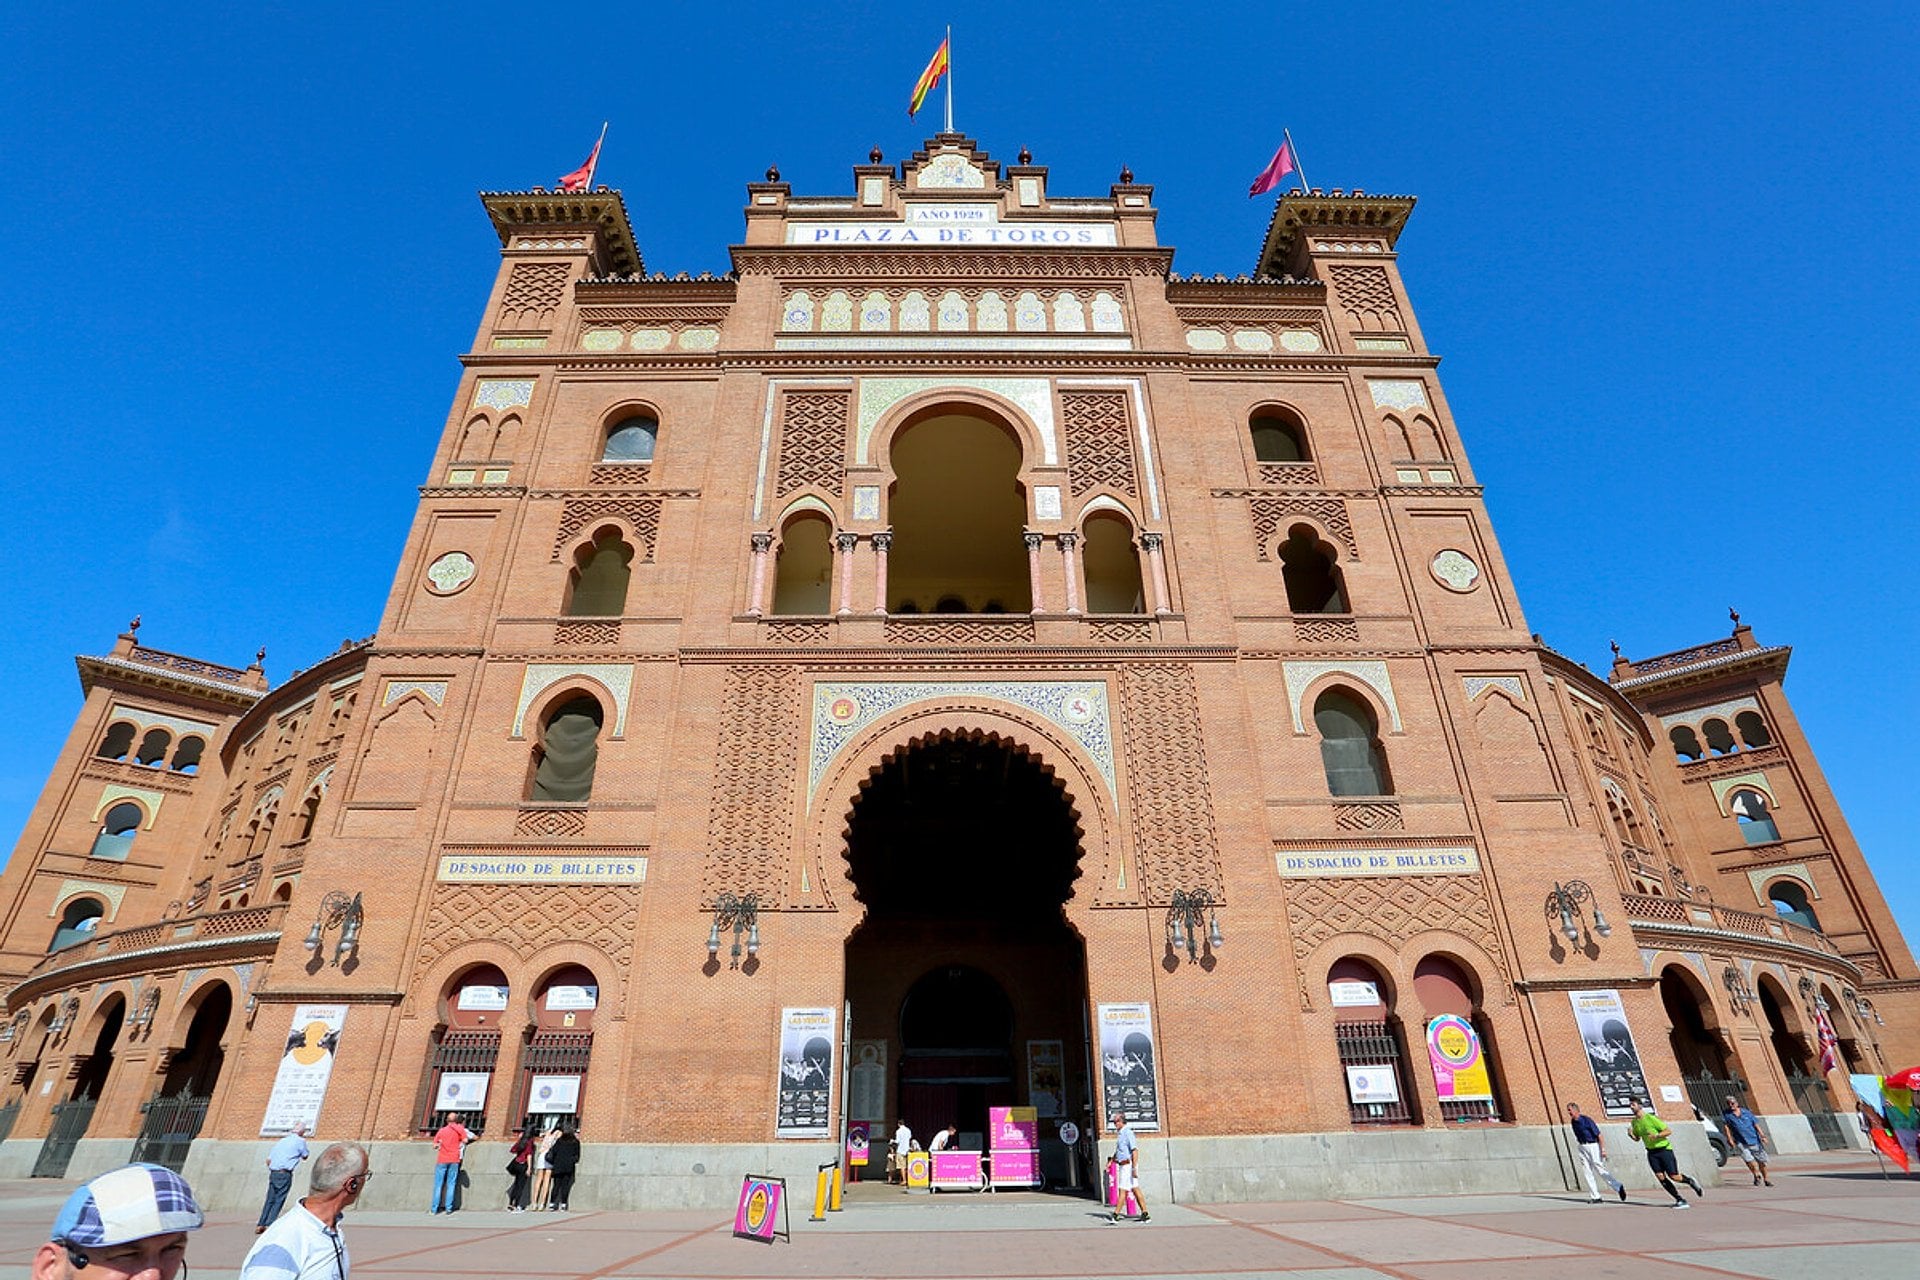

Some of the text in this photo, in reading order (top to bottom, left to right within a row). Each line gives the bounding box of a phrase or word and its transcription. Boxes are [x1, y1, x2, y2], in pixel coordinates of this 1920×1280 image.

[919, 208, 983, 219] AÑO 1929
[814, 229, 1093, 243] PLAZA DE TOROS
[449, 862, 635, 875] DESPACHO DE BILLETES
[1286, 855, 1467, 869] DESPACHO DE BILLETES
